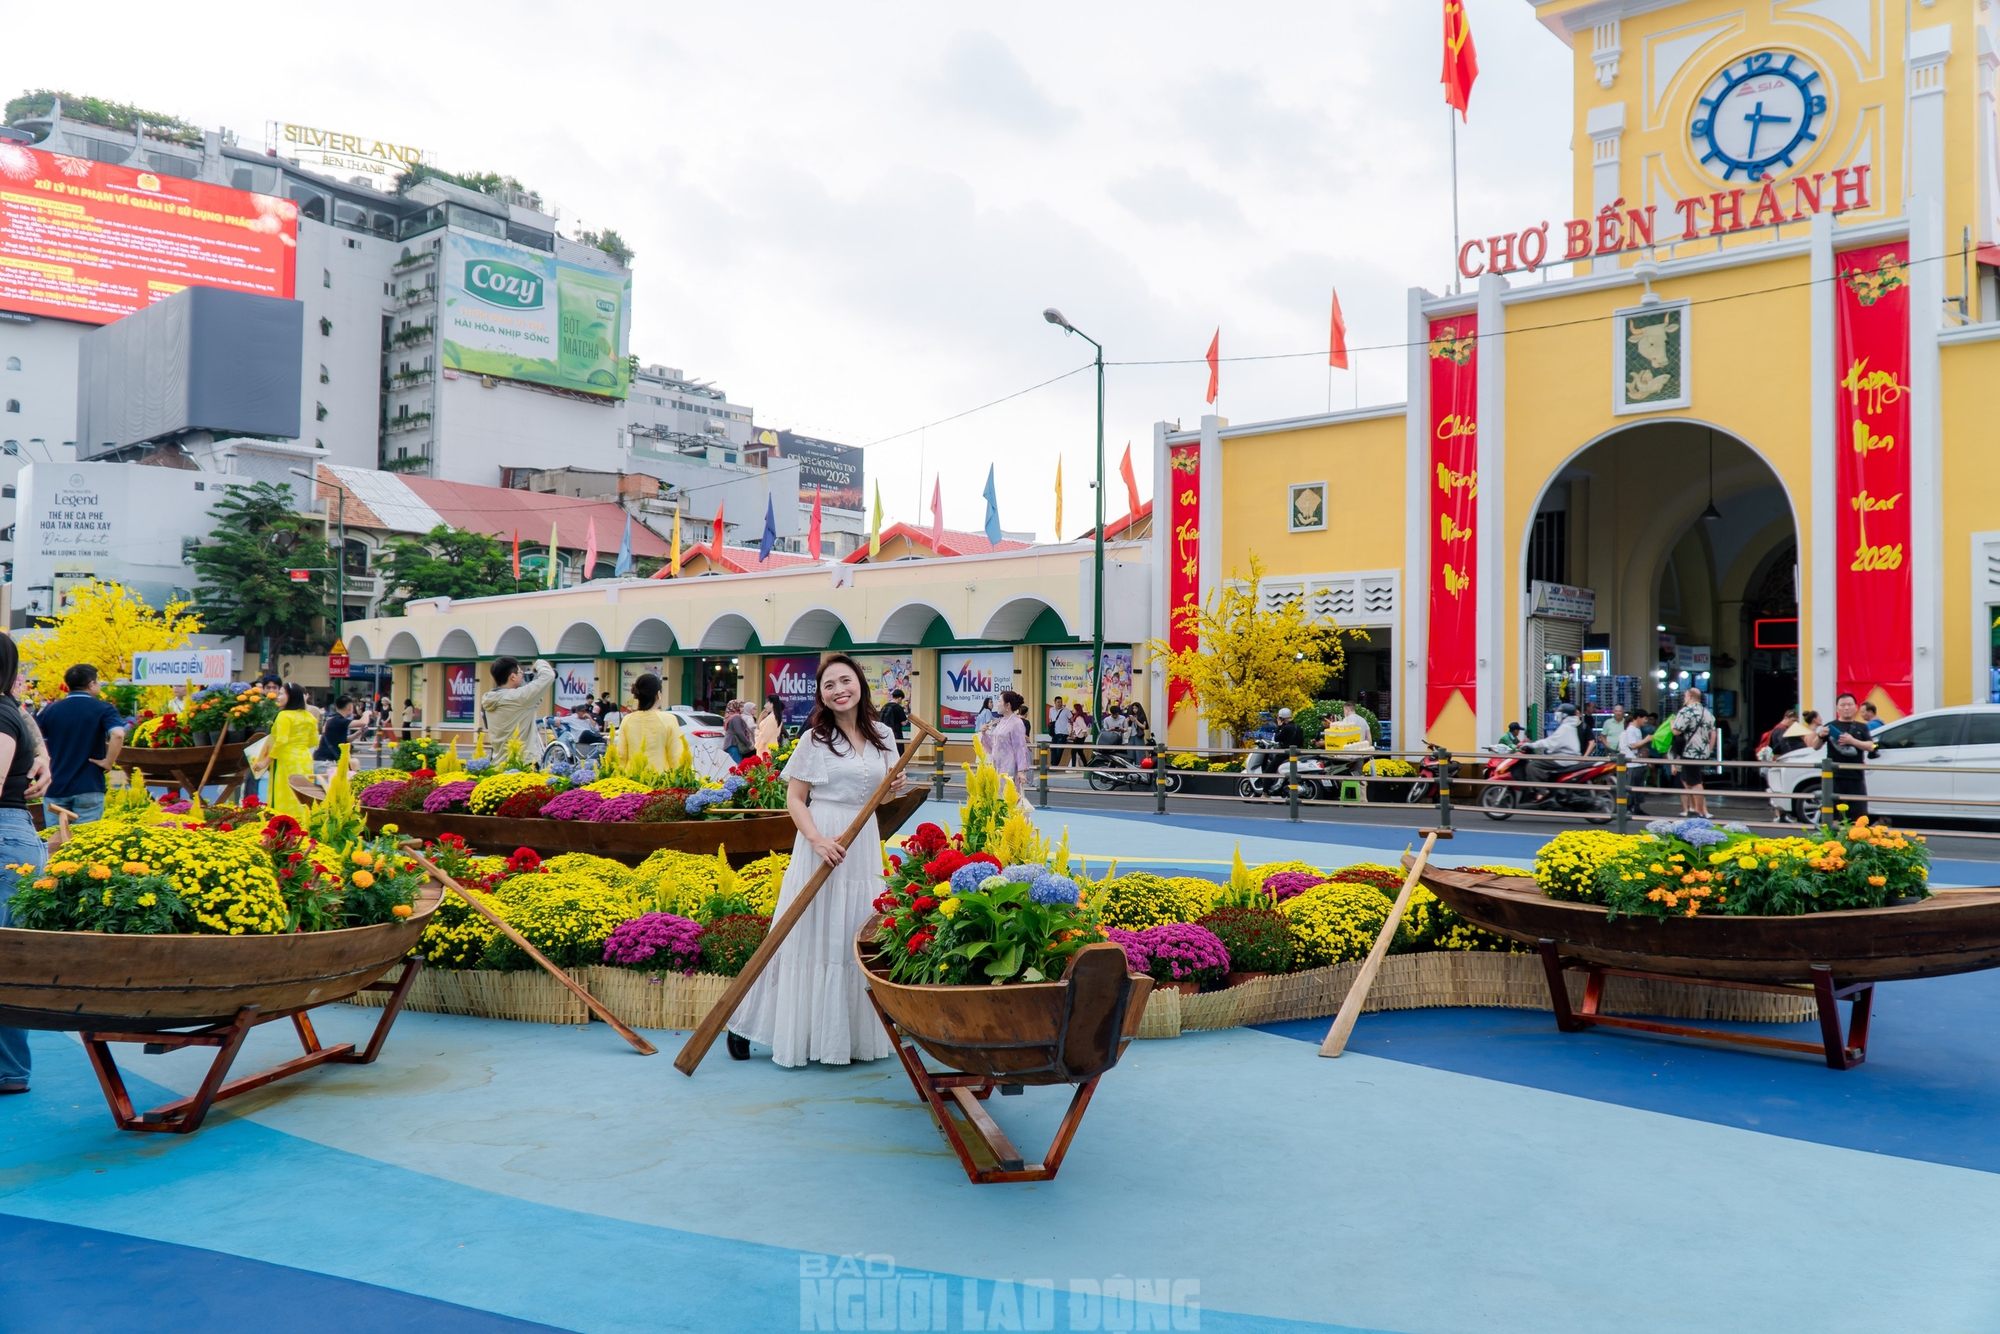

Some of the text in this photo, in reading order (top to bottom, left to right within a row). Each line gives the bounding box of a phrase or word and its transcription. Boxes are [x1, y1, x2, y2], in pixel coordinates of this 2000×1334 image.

[1743, 52, 1773, 76] 12
[1810, 95, 1827, 116] 3
[1691, 118, 1709, 138] 9
[284, 123, 420, 164] SILVERLAND
[323, 155, 385, 174] BEN THANH
[1747, 162, 1767, 182] 6
[34, 179, 51, 191] XỬ
[53, 182, 65, 193] LÝ
[67, 185, 79, 196] VI
[81, 187, 113, 202] PHẠM
[115, 194, 128, 205] VỀ
[130, 196, 161, 211] QUẢN
[164, 203, 175, 213] LÝ
[178, 205, 191, 216] SỬ
[193, 208, 222, 222] DỤNG
[1459, 165, 1871, 277] CHỢ BẾN THÀNH
[471, 264, 536, 303] Cozy
[597, 300, 614, 311] Cozy
[454, 316, 550, 344] HÀI HÒA NHỊP SỐNG
[563, 316, 580, 336] BỘT
[563, 336, 599, 360] MATCHA
[1841, 356, 1911, 414] Happy
[1437, 414, 1476, 439] Chúc
[827, 470, 850, 484] 2025
[54, 493, 98, 507] Legend
[97, 521, 111, 530] XAY
[1852, 490, 1903, 549] Year
[1851, 543, 1902, 571] 2026
[1443, 564, 1469, 600] Mới
[149, 654, 225, 678] KHANG ĐIỀN 2026
[1694, 654, 1709, 664] WATCH
[449, 670, 472, 695] Vikki
[559, 669, 586, 694] Vikki
[769, 663, 806, 693] Vikki
[947, 658, 992, 692] Vikki
